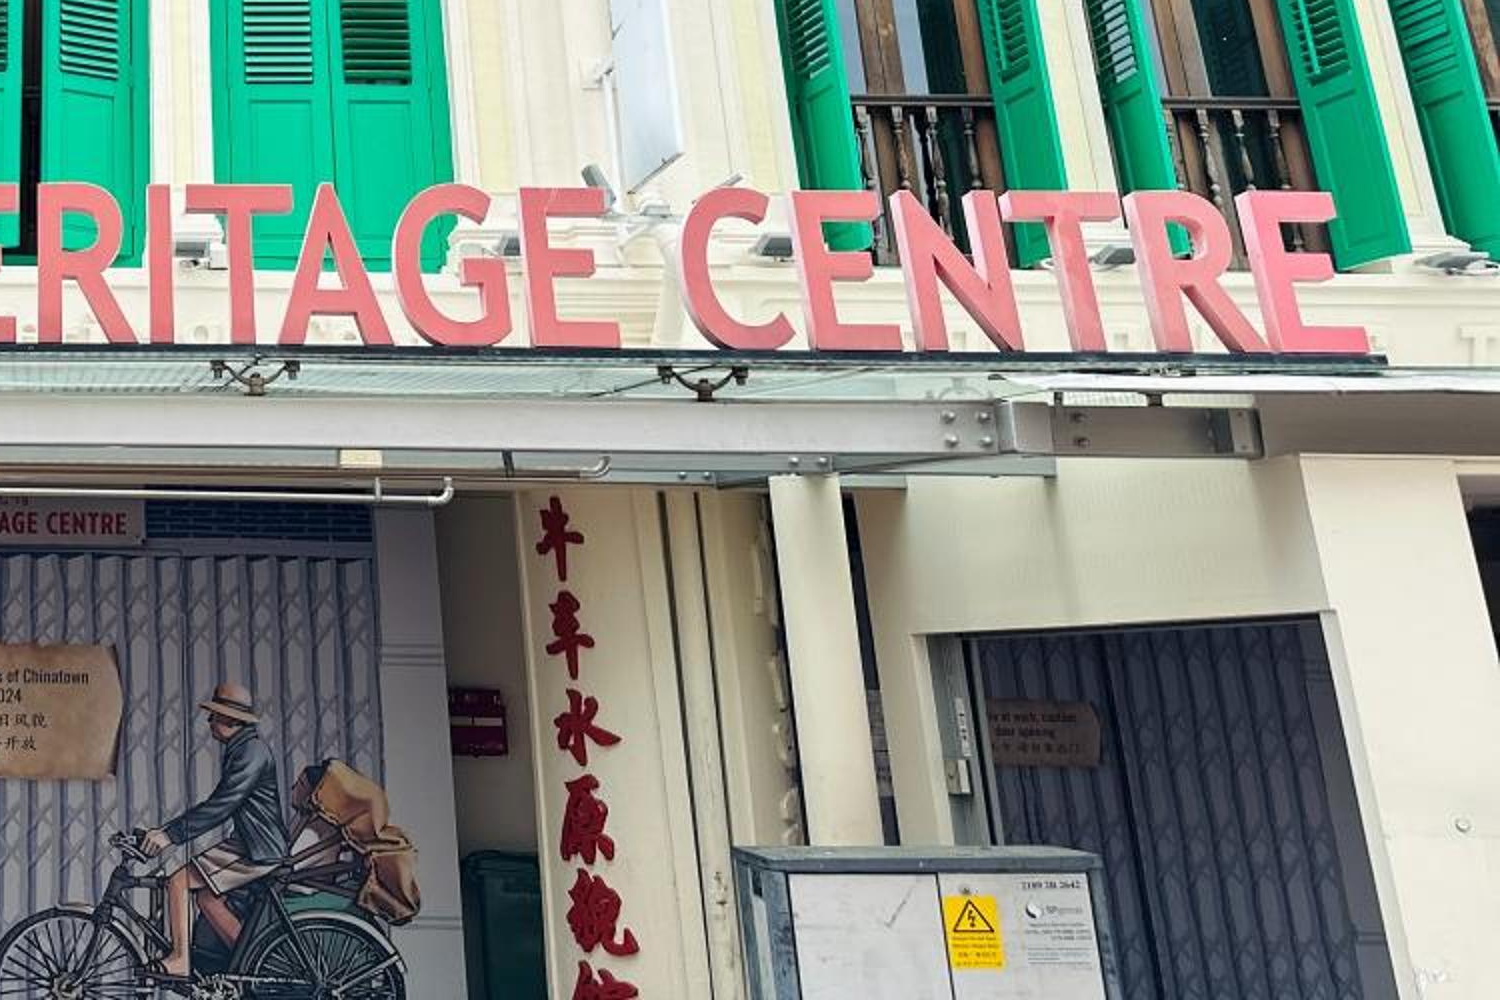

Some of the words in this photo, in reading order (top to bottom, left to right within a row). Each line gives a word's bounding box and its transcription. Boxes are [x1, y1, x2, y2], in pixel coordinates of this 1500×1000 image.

[680, 186, 1372, 354] CENTRE
[46, 512, 127, 535] CENTRE
[6, 669, 19, 683] of
[23, 668, 89, 685] Chinatown
